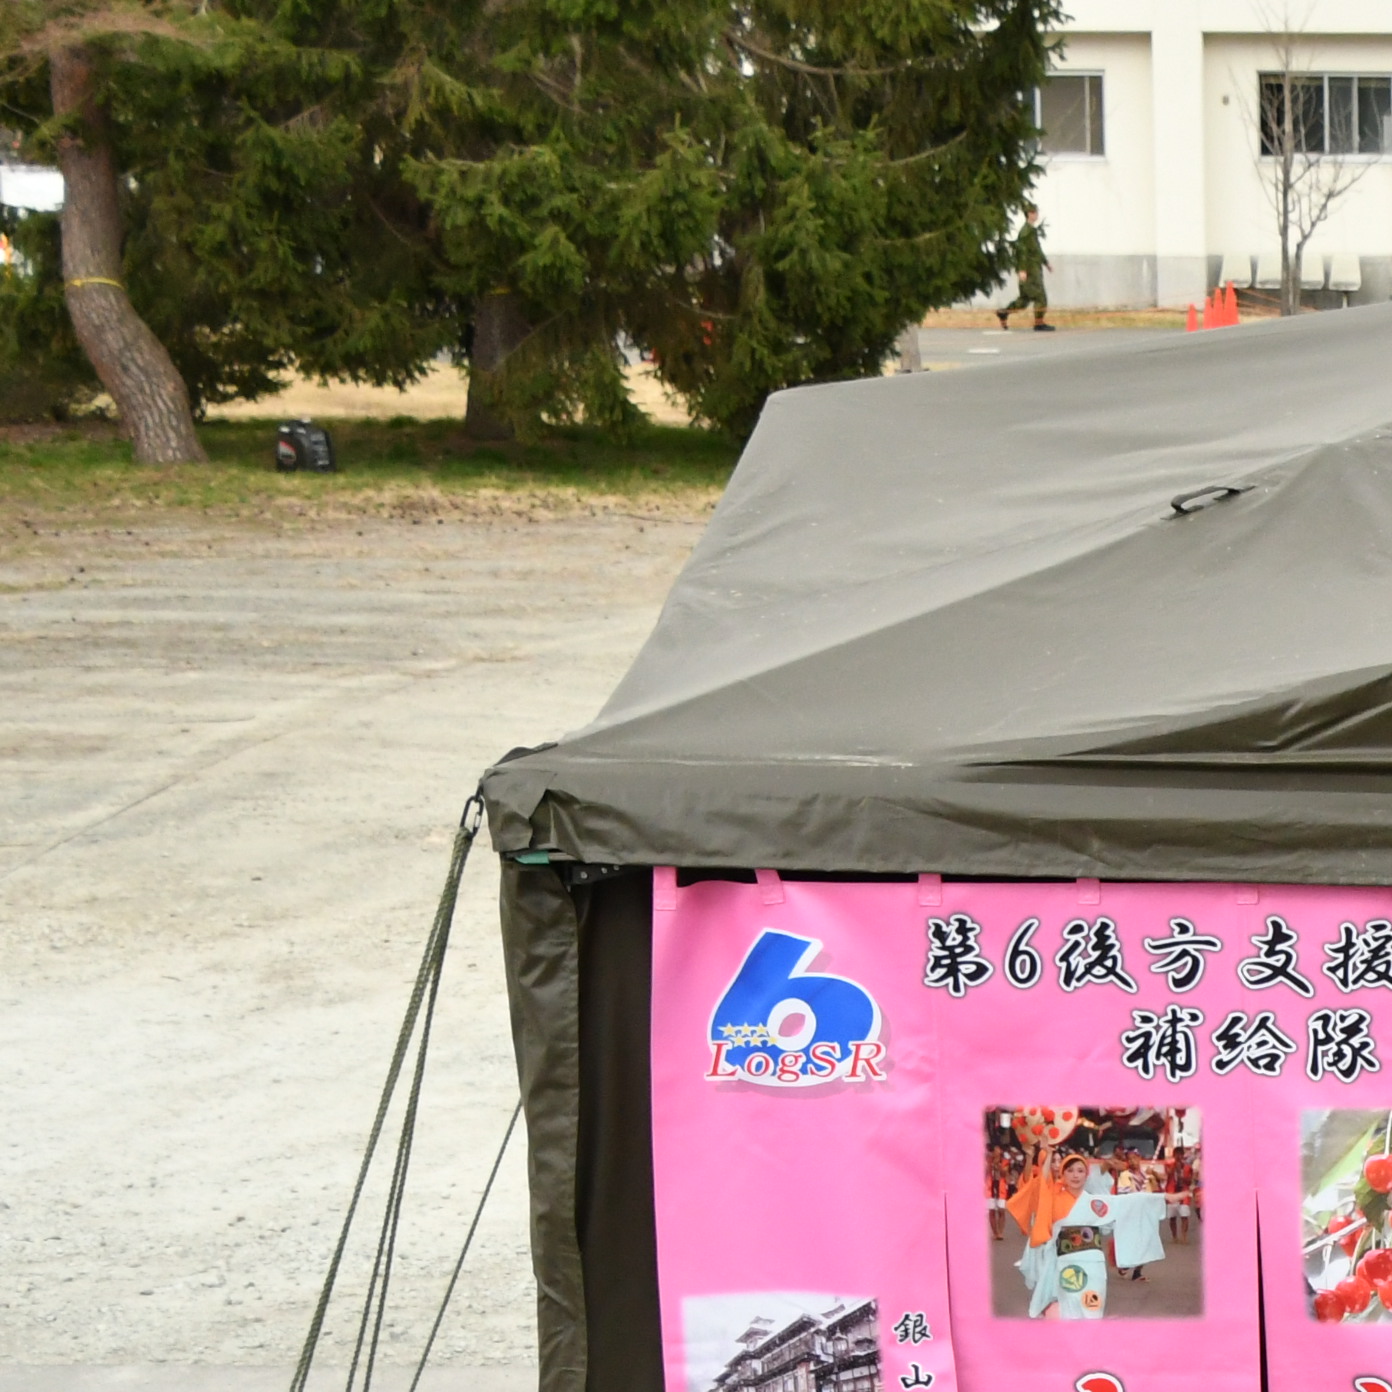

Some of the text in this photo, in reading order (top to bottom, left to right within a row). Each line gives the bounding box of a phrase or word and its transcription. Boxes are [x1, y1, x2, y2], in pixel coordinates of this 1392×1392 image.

[705, 1040, 887, 1082] LogSR
[1121, 1005, 1381, 1082] 補給隊
